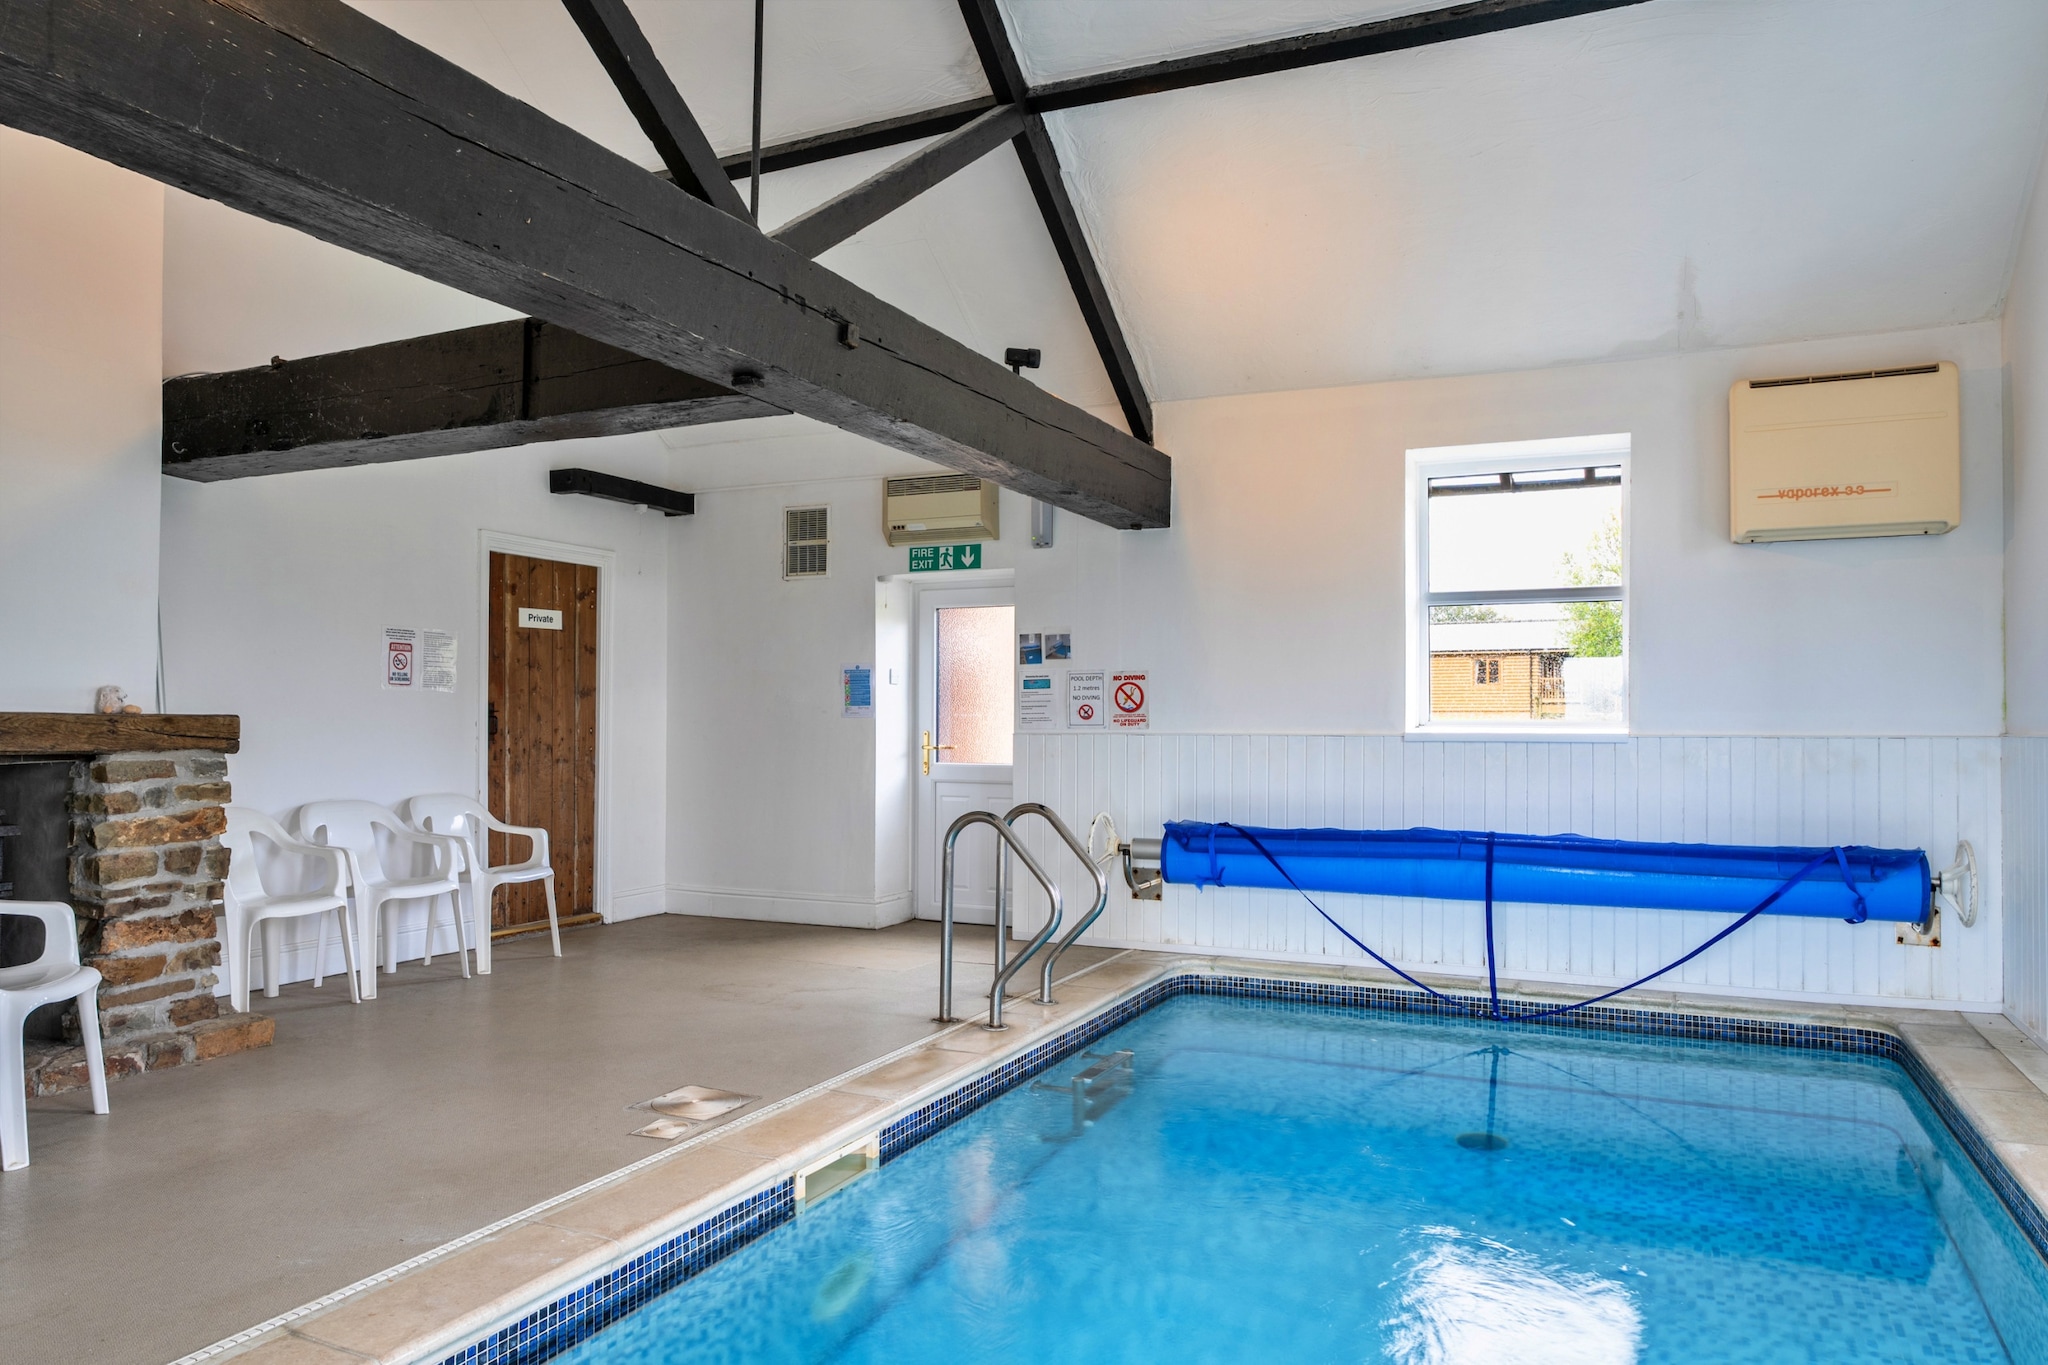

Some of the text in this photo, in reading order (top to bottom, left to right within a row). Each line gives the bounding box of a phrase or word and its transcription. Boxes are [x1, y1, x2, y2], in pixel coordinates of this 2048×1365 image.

[1778, 486, 1839, 501] vaporex
[912, 548, 934, 558] FIRE
[912, 560, 934, 569] EXIT
[528, 613, 554, 624] Private
